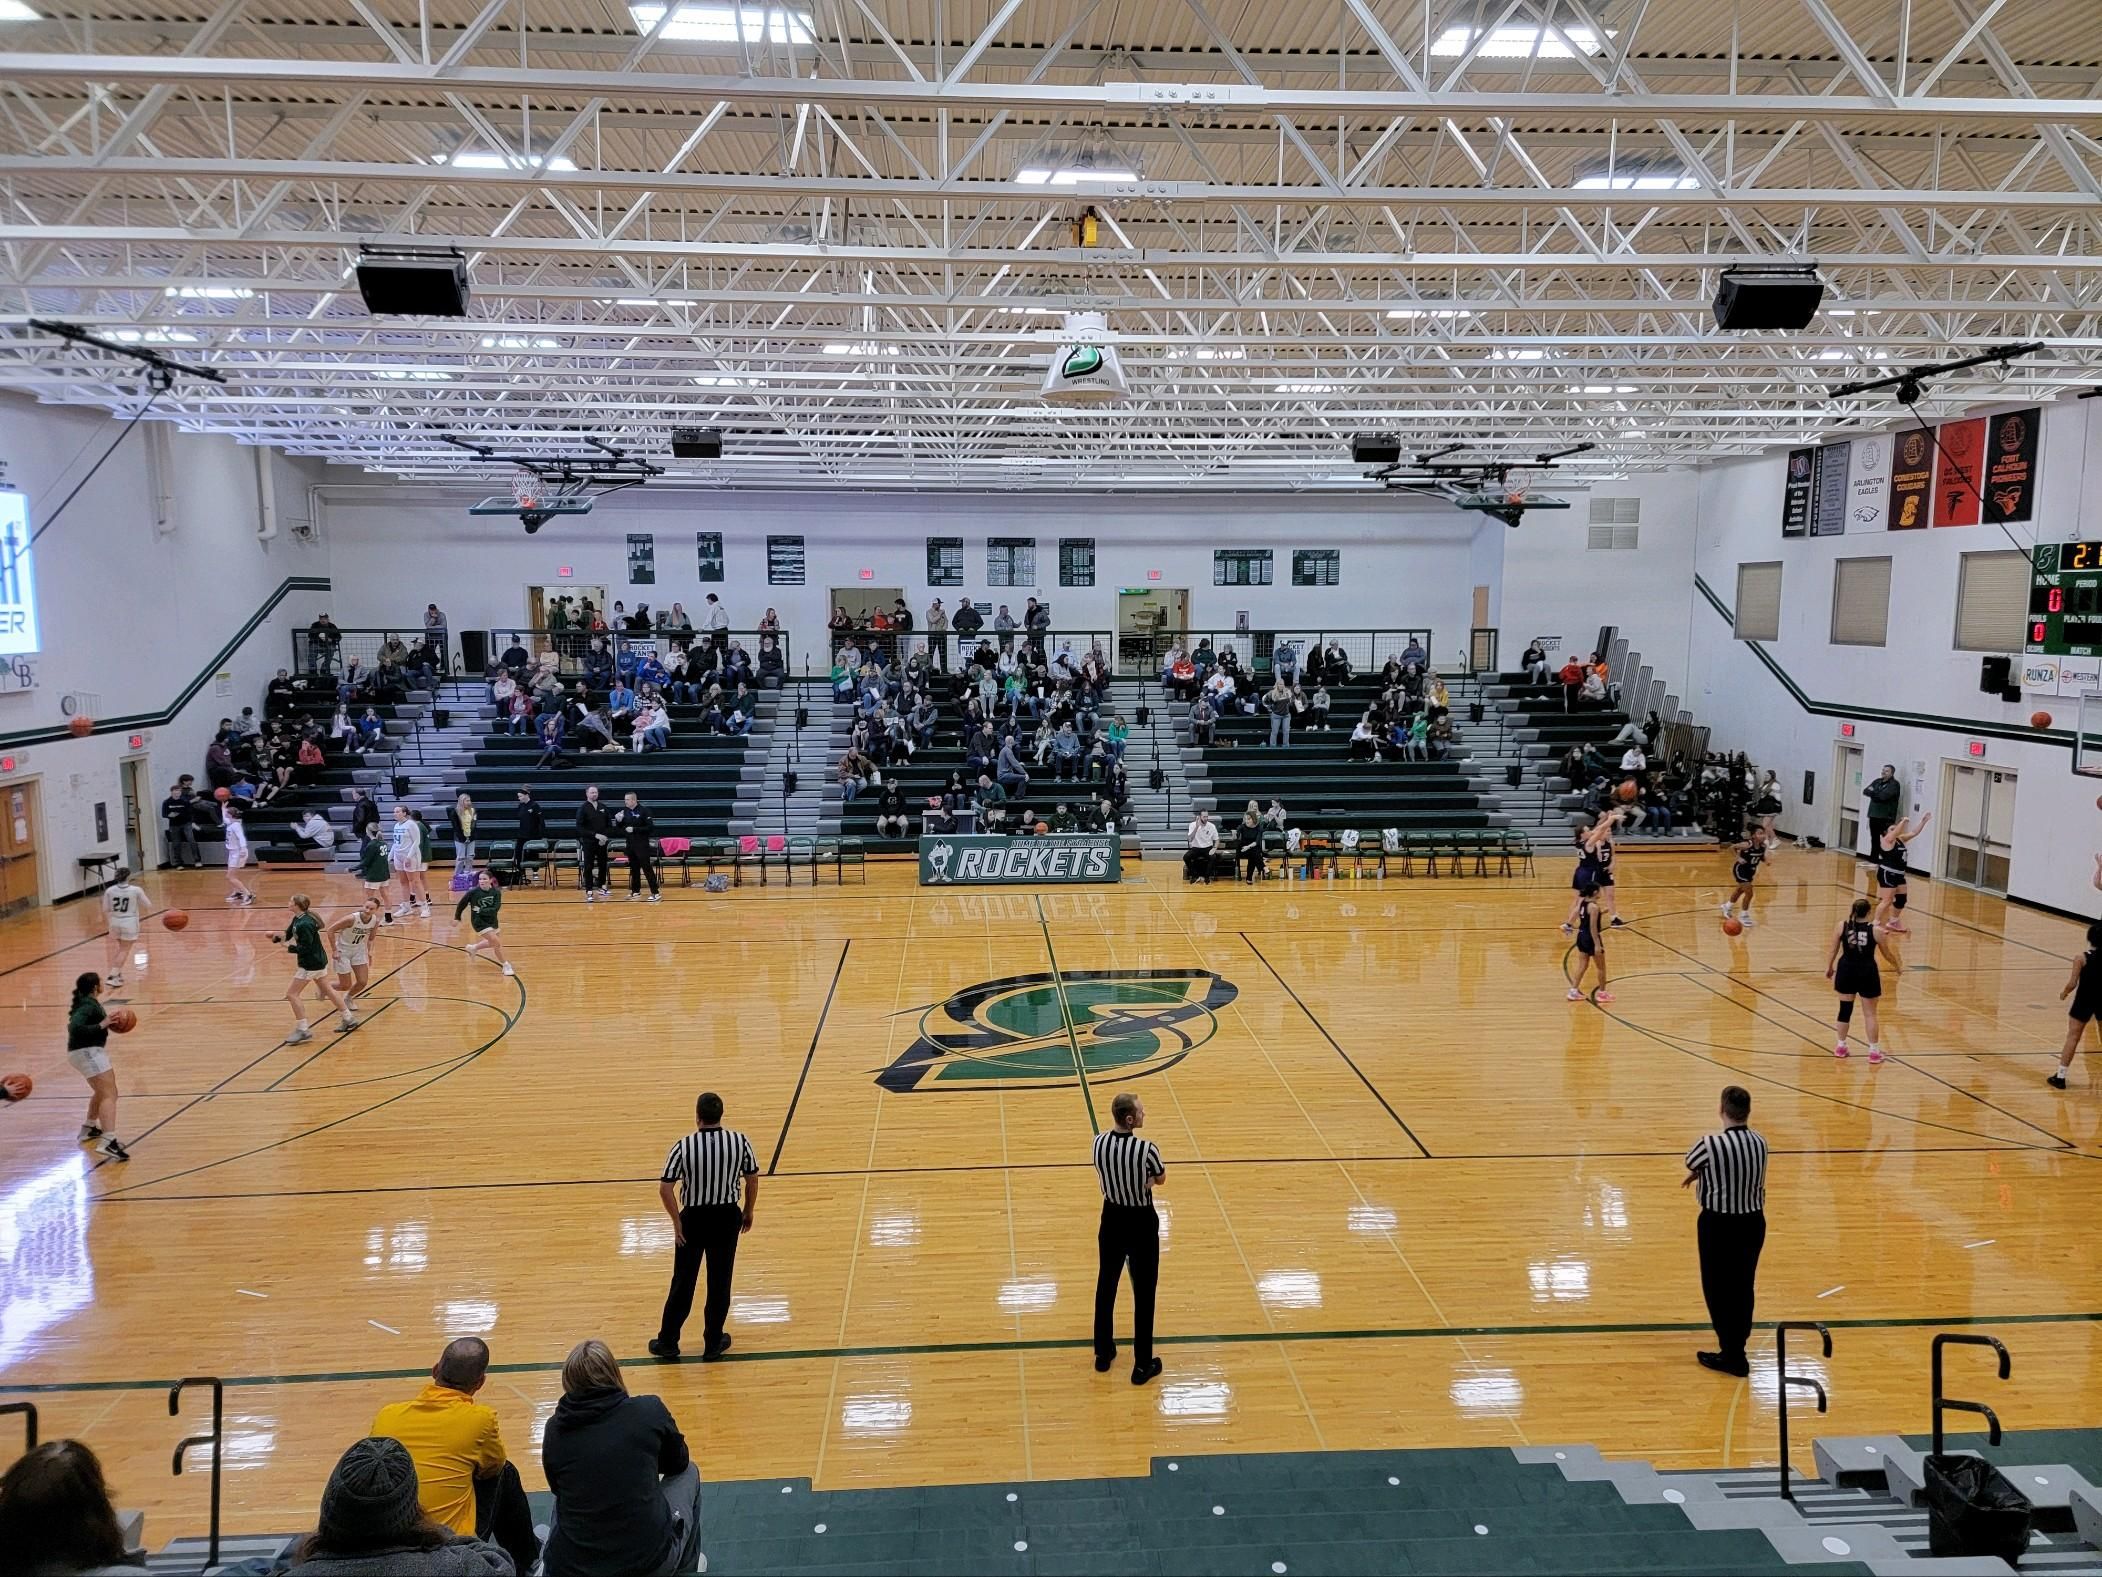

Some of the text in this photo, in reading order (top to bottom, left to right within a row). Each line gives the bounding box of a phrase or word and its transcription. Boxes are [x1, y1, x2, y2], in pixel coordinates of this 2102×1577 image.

[1071, 377, 1110, 386] WRESTLING
[1894, 471, 1929, 482] CONESTOGA
[1853, 477, 1885, 487] ARLINGTON
[1858, 487, 1879, 495] EAGLES
[2076, 580, 2097, 588] PERIOD
[2029, 614, 2047, 623] FOULS
[2025, 669, 2054, 682] RUNZA
[2072, 672, 2098, 681] WESTERN
[955, 847, 1112, 879] ROCKETS
[112, 896, 130, 913] 20
